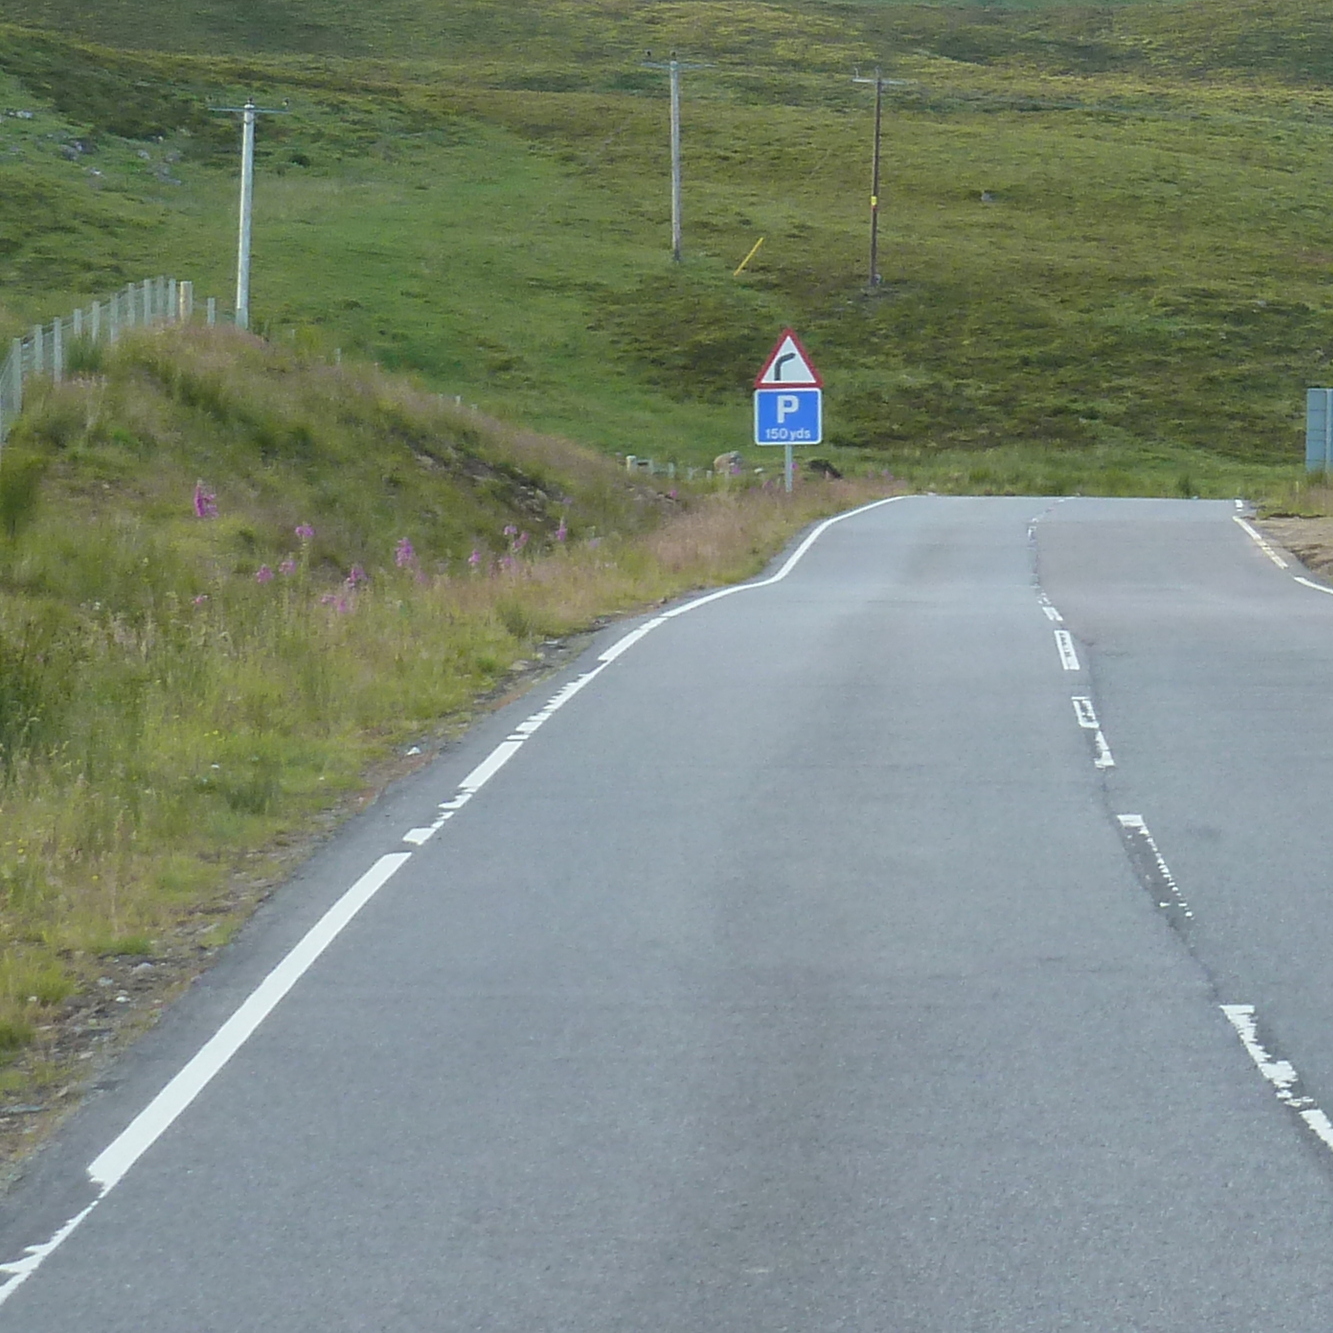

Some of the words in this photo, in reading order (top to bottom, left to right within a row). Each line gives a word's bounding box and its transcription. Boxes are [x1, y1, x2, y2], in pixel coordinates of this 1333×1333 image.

[777, 395, 799, 423] P
[765, 428, 788, 439] 150
[790, 428, 811, 441] yds
